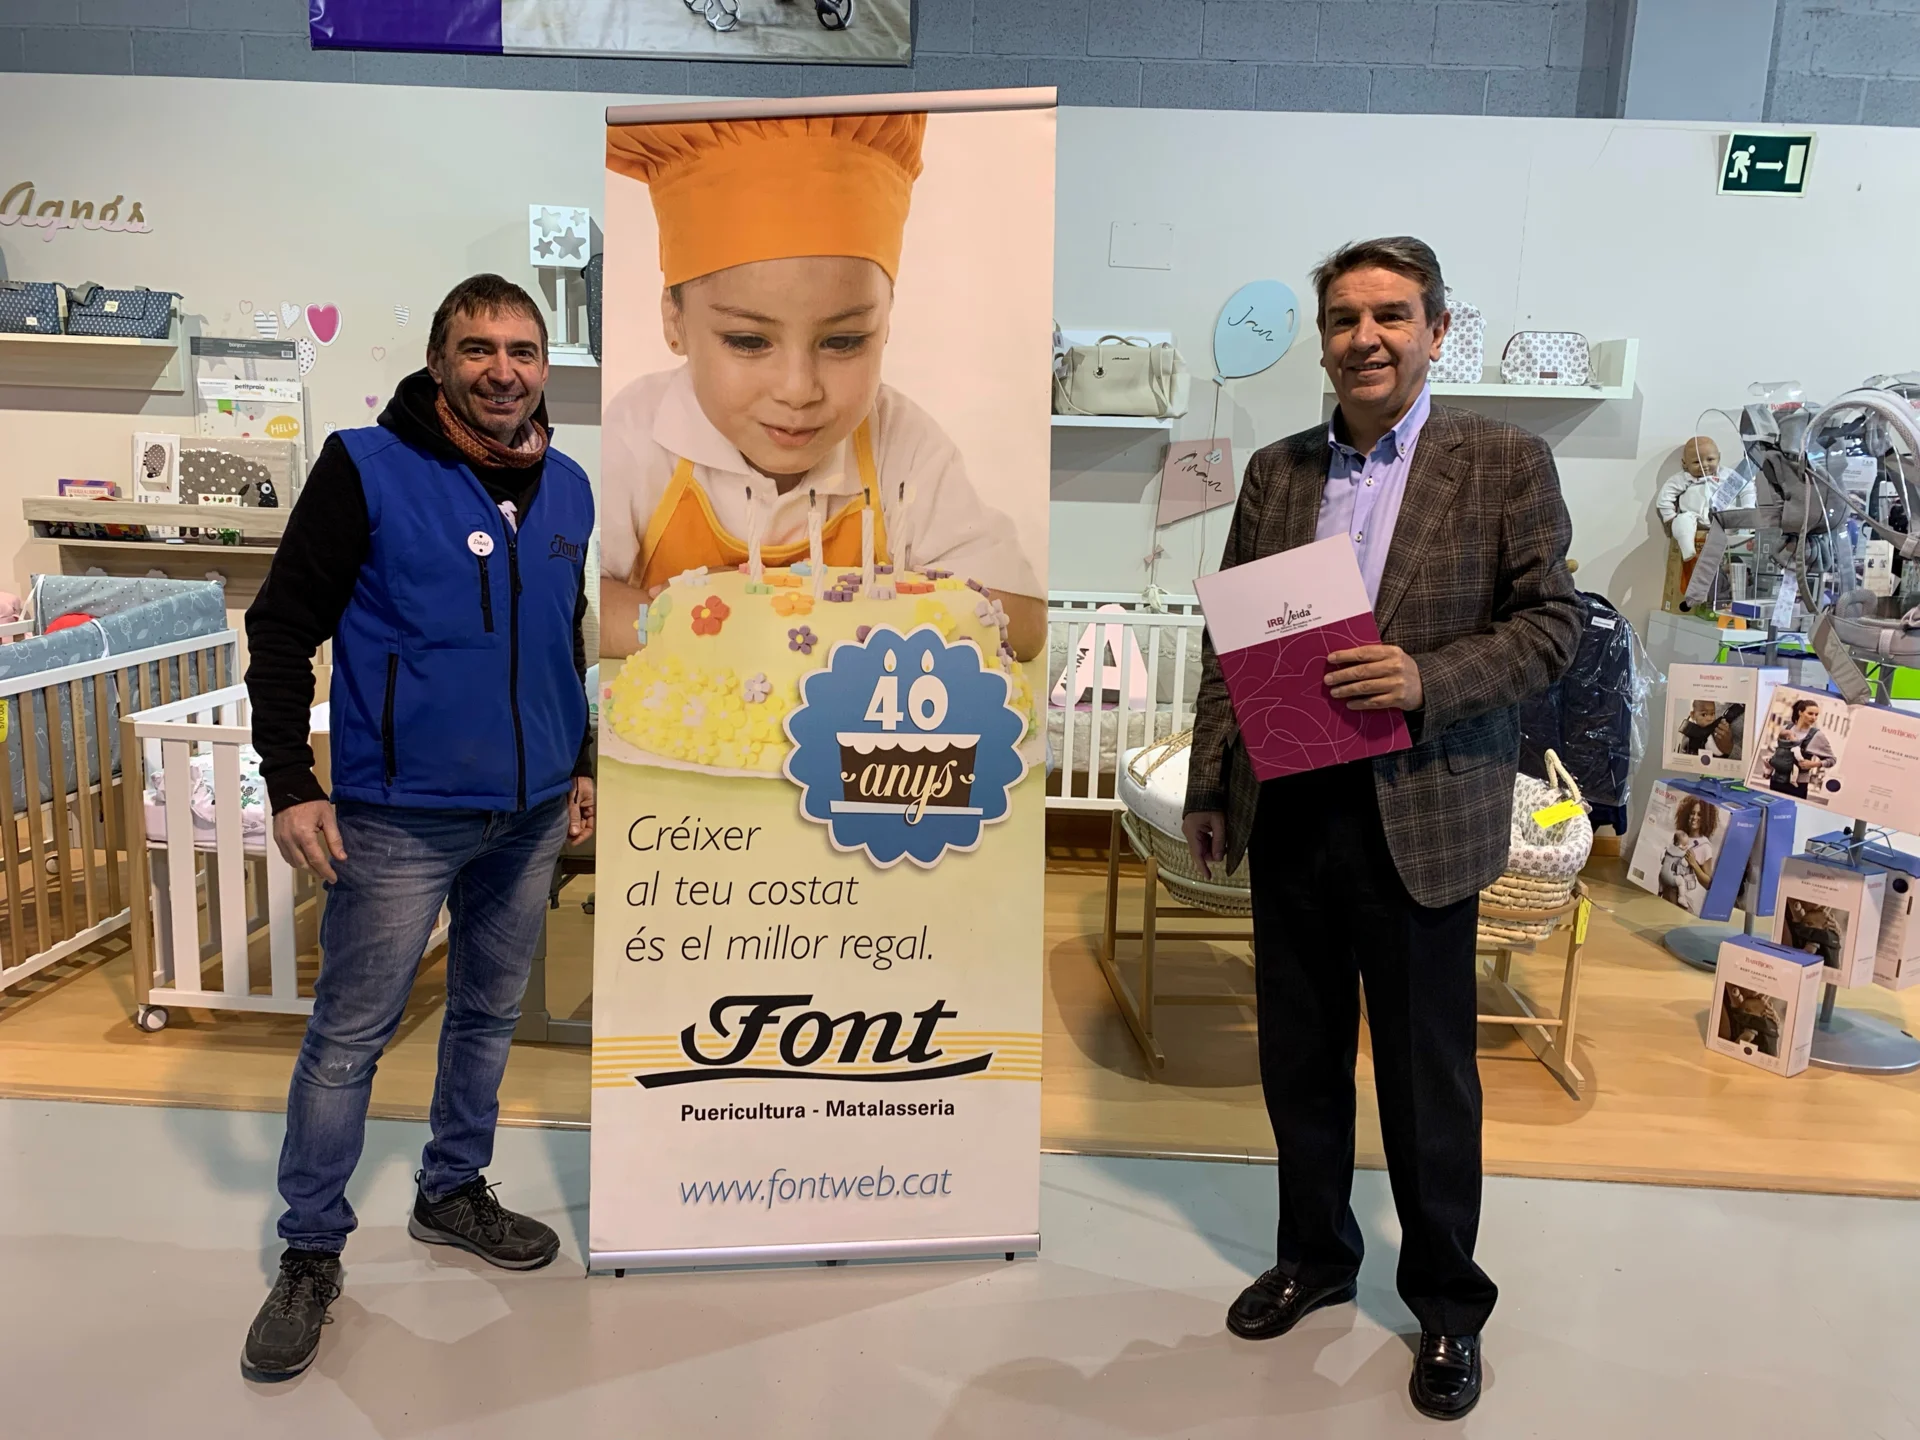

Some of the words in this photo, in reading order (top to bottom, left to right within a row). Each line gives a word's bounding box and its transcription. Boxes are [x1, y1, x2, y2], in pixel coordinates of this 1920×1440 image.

[270, 422, 299, 435] HELLO
[550, 534, 579, 558] Font
[863, 674, 949, 731] 40
[859, 759, 957, 825] anys
[627, 815, 762, 852] Créixer
[626, 870, 660, 907] al
[675, 876, 732, 905] teu
[748, 876, 859, 906] costat
[625, 926, 665, 962] és
[681, 925, 712, 961] el
[726, 925, 829, 960] millor
[840, 925, 934, 971] regal.
[680, 994, 958, 1068] Font
[681, 1102, 806, 1122] Puericultura
[826, 1099, 955, 1118] Matalasseria
[679, 1165, 953, 1209] www.fontweb.cat
